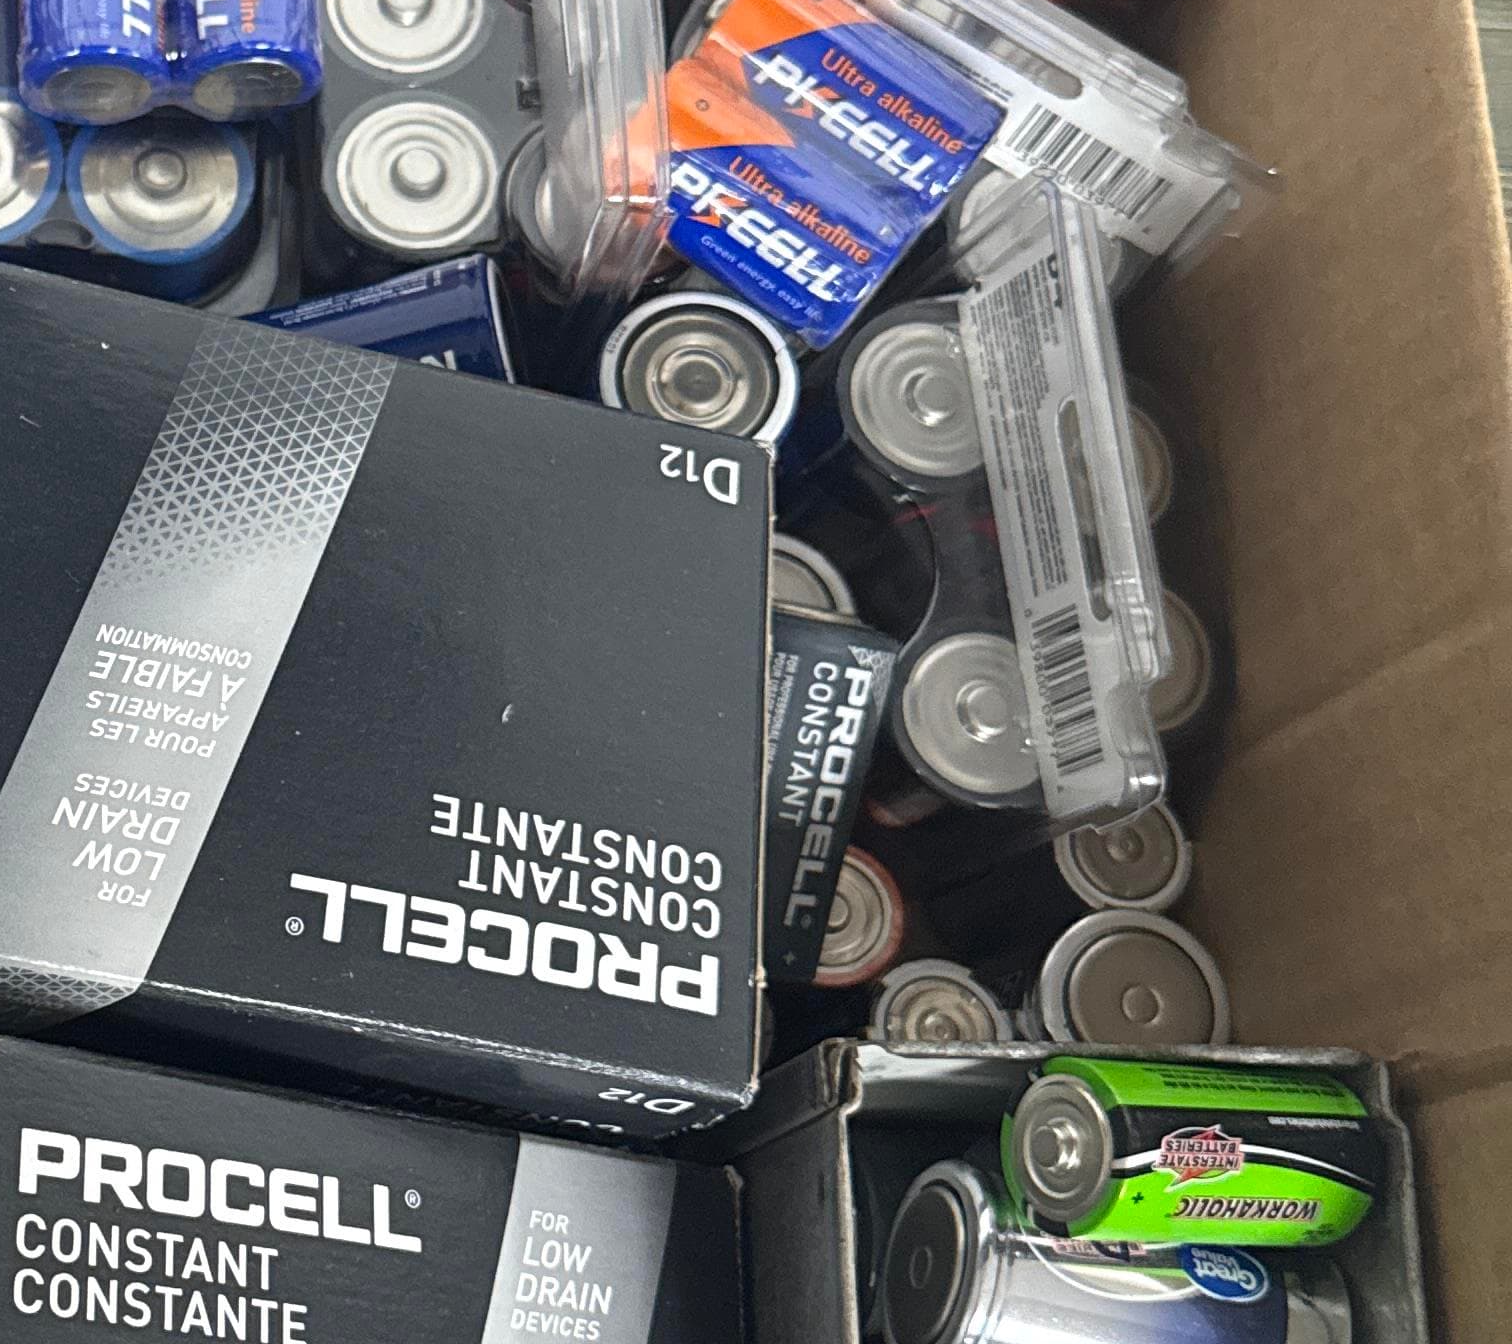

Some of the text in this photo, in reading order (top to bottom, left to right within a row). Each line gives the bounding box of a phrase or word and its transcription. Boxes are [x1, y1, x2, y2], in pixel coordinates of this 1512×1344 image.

[820, 47, 966, 156] Ultra alkaline
[729, 156, 872, 266] Ultra alkaline
[700, 234, 734, 263] Green
[657, 442, 740, 506] D12
[95, 623, 252, 670] CONSOMMATION
[88, 650, 247, 711] À FAIBLE
[86, 690, 229, 732] APPAREILS
[89, 718, 217, 757] POUR LES
[778, 661, 838, 827] CONSTANT
[73, 773, 191, 811] DEVICES
[783, 666, 873, 928] PROCELL
[51, 796, 181, 846] DRAIN
[72, 840, 167, 881] LOW
[429, 793, 724, 891] CONSTANTE
[97, 880, 152, 907] FOR
[458, 849, 723, 940] CONSTANT
[289, 872, 720, 1017] PROCELL
[597, 1087, 695, 1115] D12
[1159, 1153, 1240, 1170] INTERSTATE
[1165, 1138, 1237, 1153] BATTERIES
[17, 1126, 423, 1253] PROCELL
[1173, 1196, 1319, 1221] WORKAHOLIC
[528, 1209, 570, 1234] FOR
[14, 1212, 280, 1291] CONSTANT
[521, 1237, 593, 1272] LOW
[1193, 1258, 1258, 1291] Great
[513, 1275, 613, 1316] DRAIN
[509, 1309, 601, 1342] DEVICES
